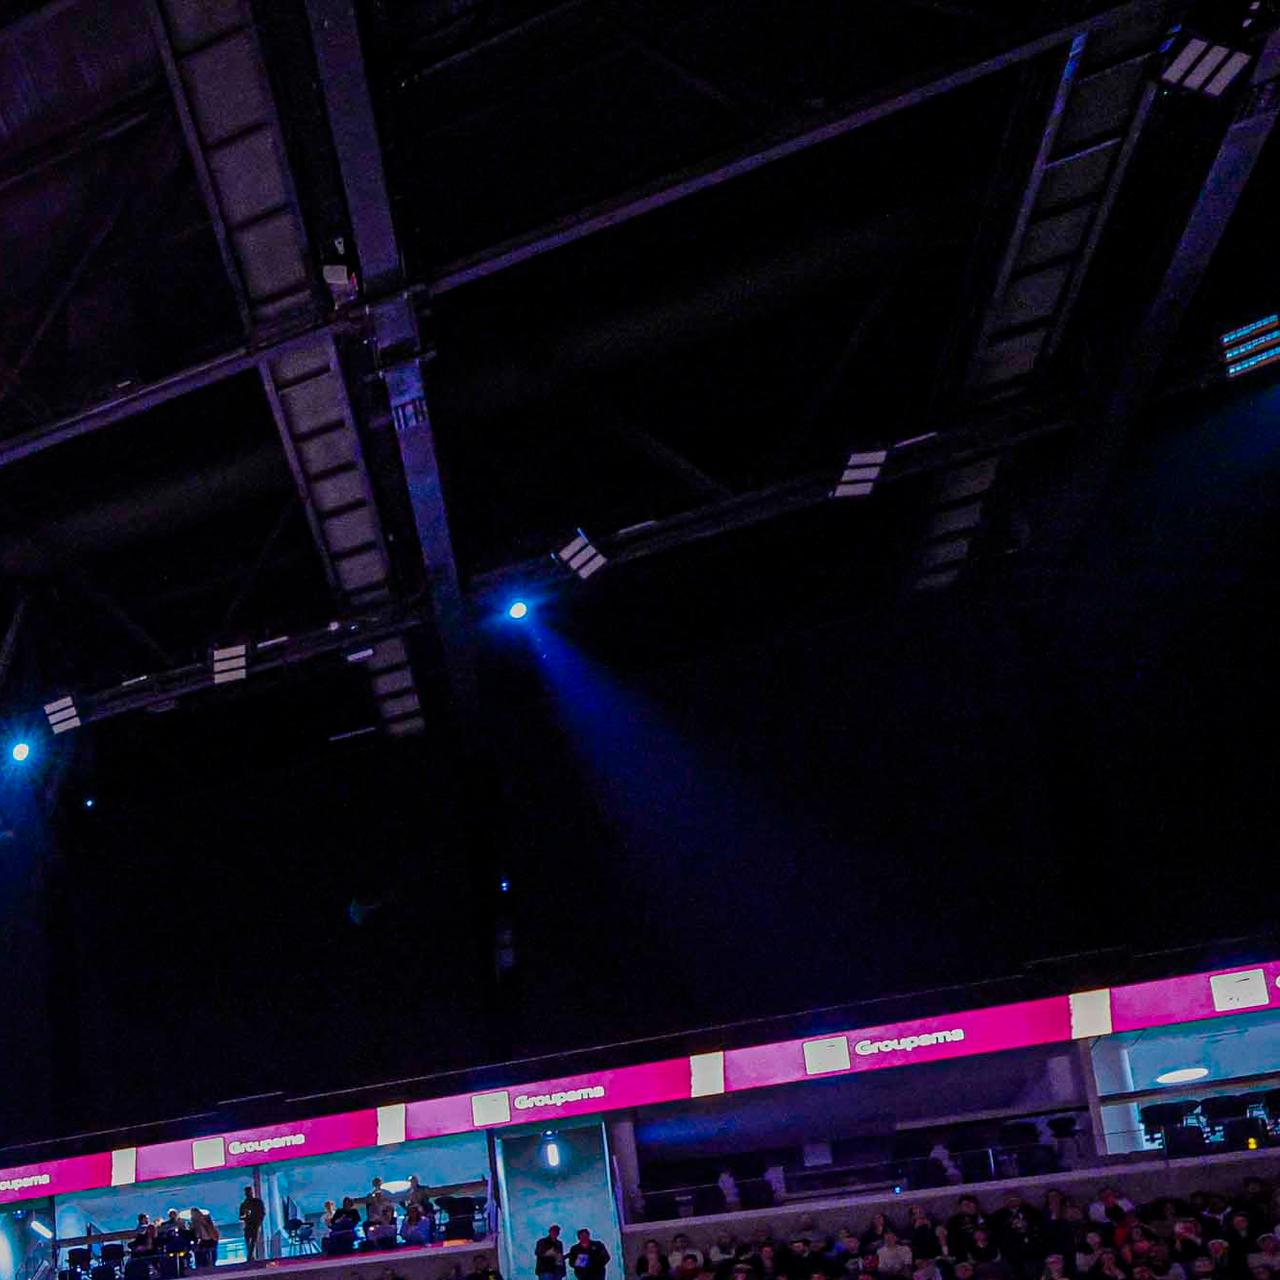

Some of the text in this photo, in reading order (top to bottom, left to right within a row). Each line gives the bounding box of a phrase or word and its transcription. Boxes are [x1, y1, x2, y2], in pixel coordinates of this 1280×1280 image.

[855, 1029, 964, 1055] Groupama
[514, 1086, 604, 1109] Groupama
[229, 1134, 305, 1154] Groupama
